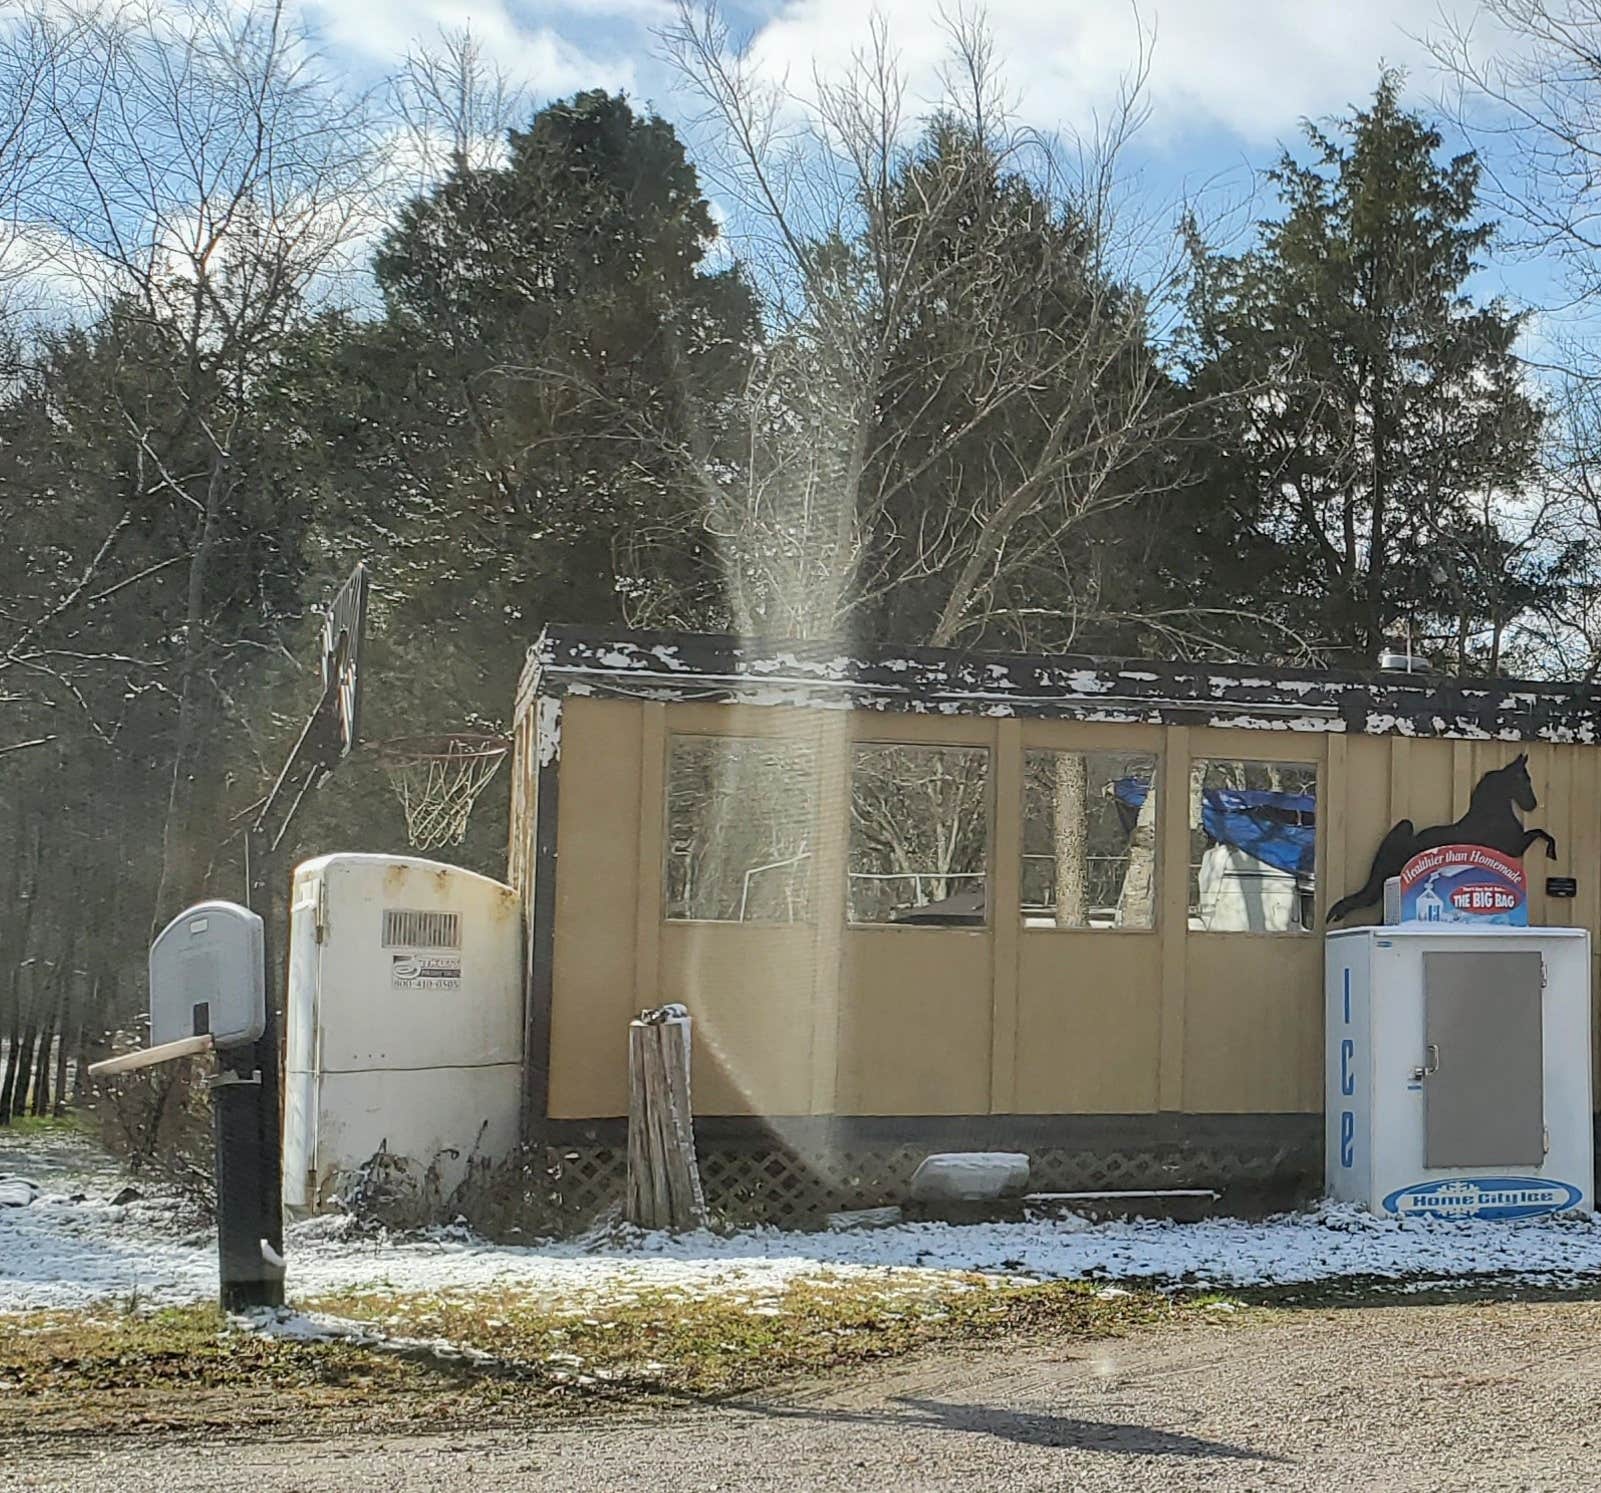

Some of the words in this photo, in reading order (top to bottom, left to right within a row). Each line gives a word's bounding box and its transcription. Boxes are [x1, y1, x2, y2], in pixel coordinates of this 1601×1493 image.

[1401, 854, 1444, 884] Healthier
[1446, 850, 1467, 862] than
[1470, 850, 1522, 883] Homemade
[1453, 892, 1471, 907] THE
[1472, 891, 1493, 908] BIG
[1495, 893, 1515, 908] BAG
[1413, 1195, 1474, 1207] Home
[1478, 1193, 1518, 1206] City
[1520, 1191, 1553, 1202] Ice
